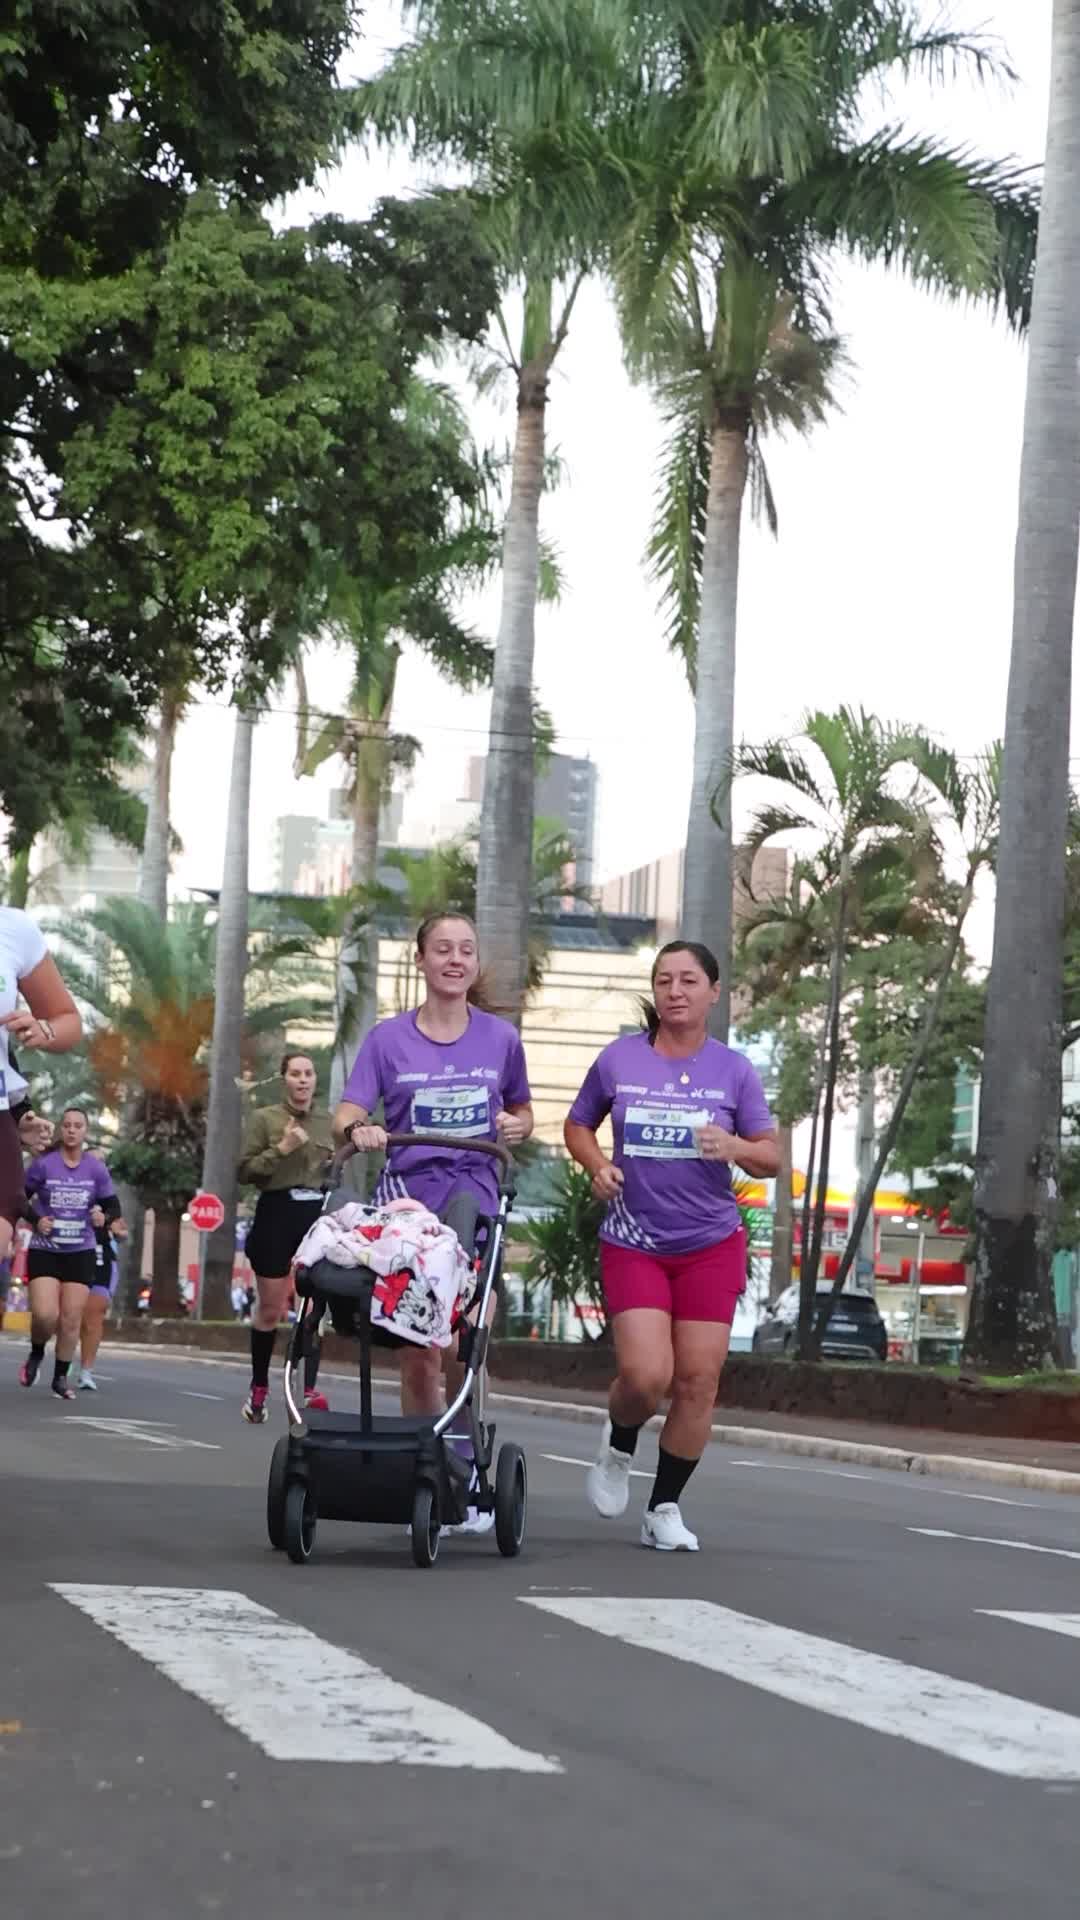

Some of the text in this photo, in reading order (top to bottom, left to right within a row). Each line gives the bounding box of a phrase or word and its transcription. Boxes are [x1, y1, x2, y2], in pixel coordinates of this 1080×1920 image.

[431, 1107, 475, 1122] 5245
[641, 1126, 688, 1142] 6327
[192, 1206, 221, 1218] PARE
